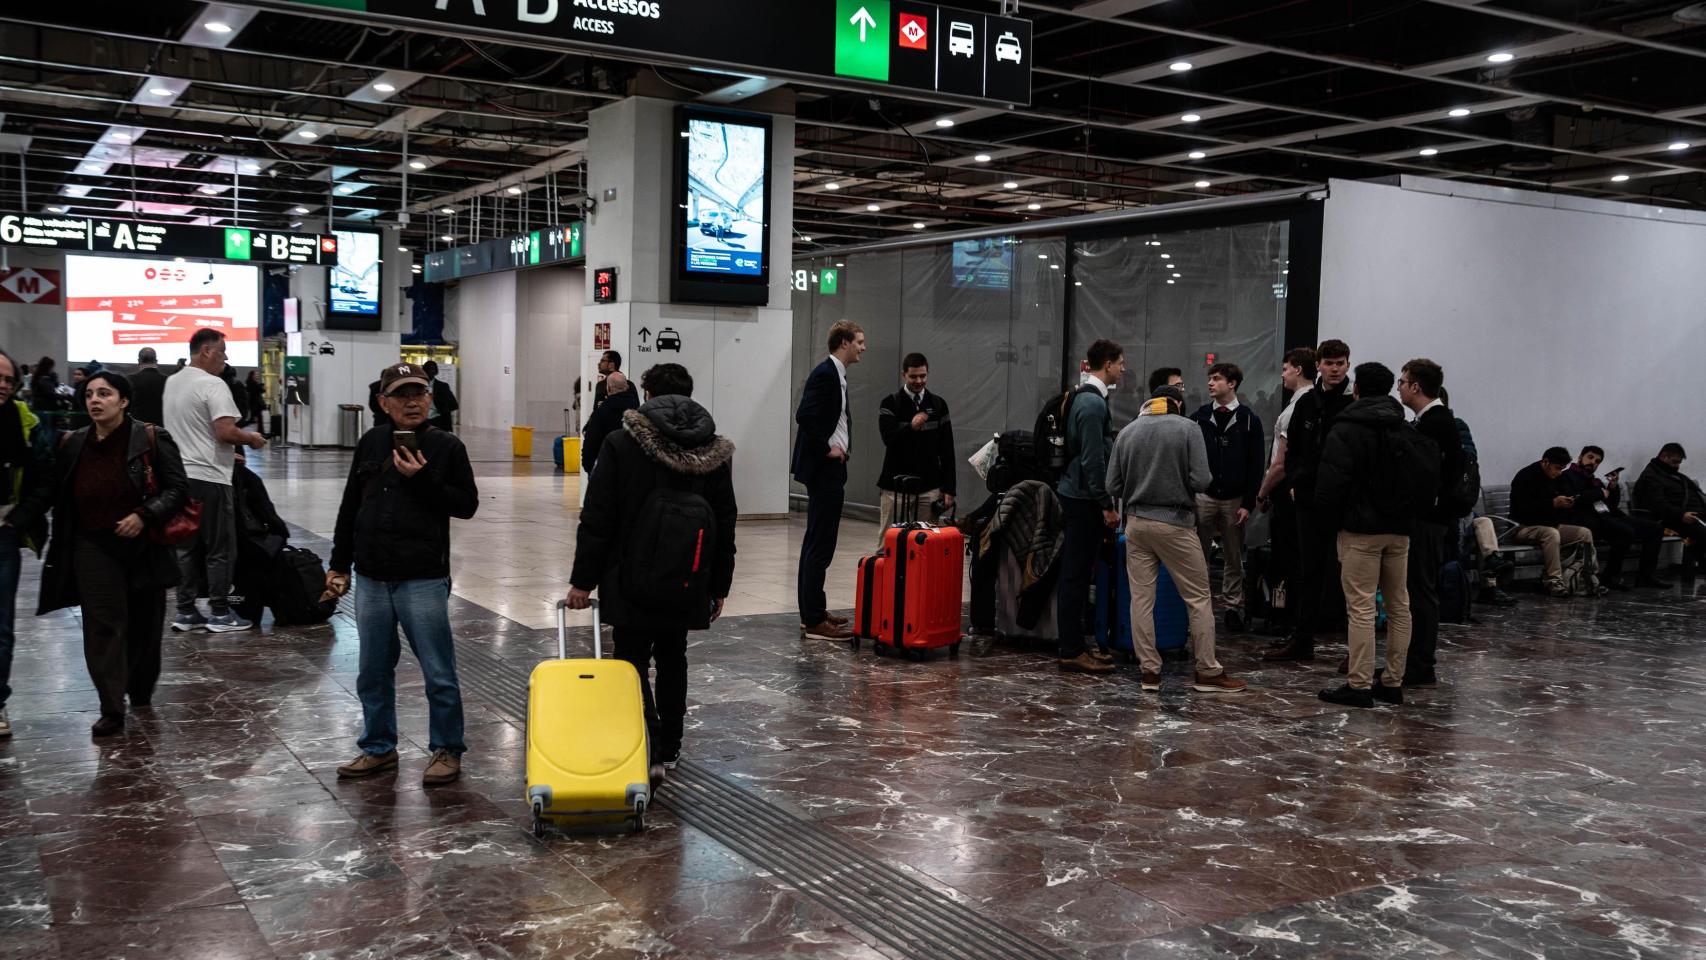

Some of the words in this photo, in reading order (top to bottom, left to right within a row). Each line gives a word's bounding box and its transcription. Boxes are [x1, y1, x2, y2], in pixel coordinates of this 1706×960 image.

[573, 16, 615, 35] ACCESS
[908, 26, 918, 37] M
[0, 214, 23, 243] 6
[113, 223, 136, 250] A
[271, 234, 289, 260] B
[17, 276, 40, 294] M
[637, 345, 652, 353] Taxi
